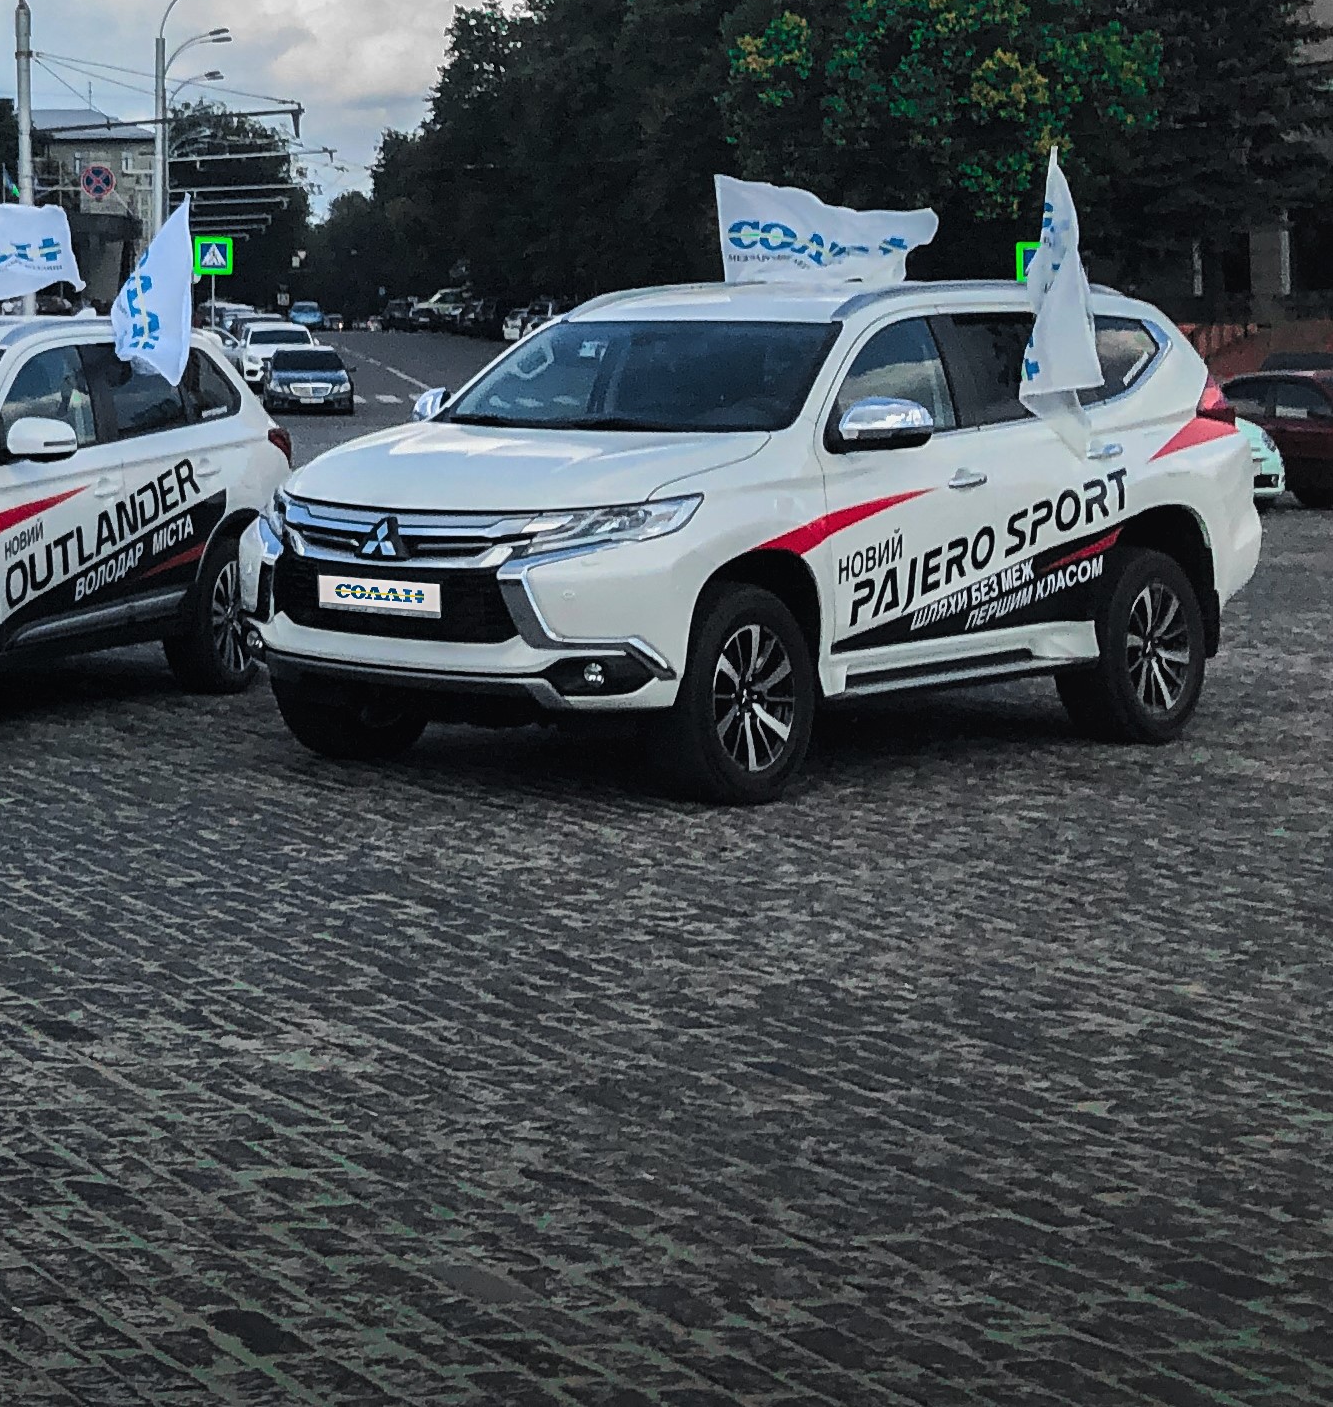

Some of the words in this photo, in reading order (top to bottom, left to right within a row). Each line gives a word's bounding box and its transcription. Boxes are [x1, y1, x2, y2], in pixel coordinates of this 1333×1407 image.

[4, 518, 45, 561] НОВИЙ
[5, 458, 202, 610] OUTLANDER
[74, 543, 144, 602] ВОЛОДАР
[152, 514, 195, 556] МІСТА
[838, 527, 904, 585] НОВИЙ
[849, 525, 995, 628] PAJERO
[1004, 467, 1128, 558] SPORT
[910, 591, 969, 631] ШЛЯХИ
[971, 573, 999, 603] БЕЗ
[1001, 556, 1035, 590] МЕЖ
[964, 585, 1033, 631] ПЕРШИМ
[1035, 554, 1105, 602] КЛАСОМ
